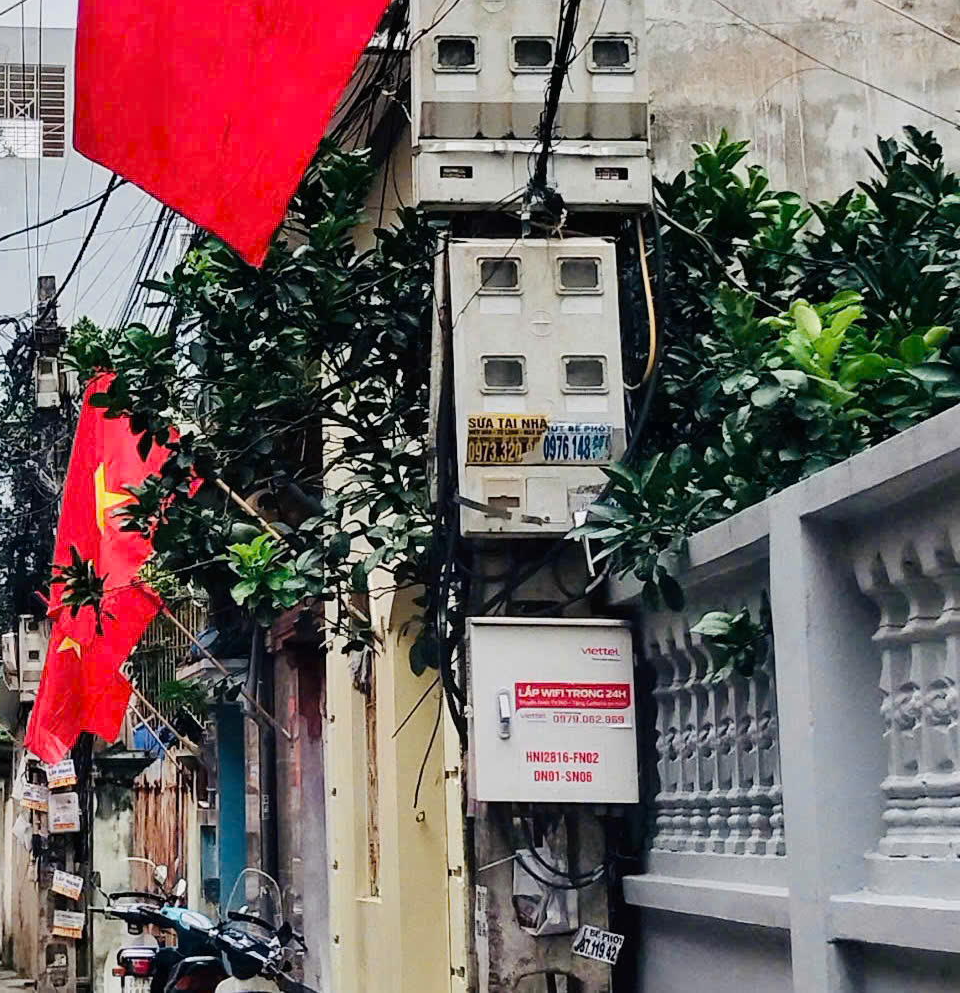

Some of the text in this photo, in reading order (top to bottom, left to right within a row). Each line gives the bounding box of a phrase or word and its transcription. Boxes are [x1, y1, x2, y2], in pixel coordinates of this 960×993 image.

[580, 646, 621, 656] viettel
[541, 689, 565, 698] WIFI
[566, 689, 604, 698] TRONG
[605, 690, 627, 699] 24H
